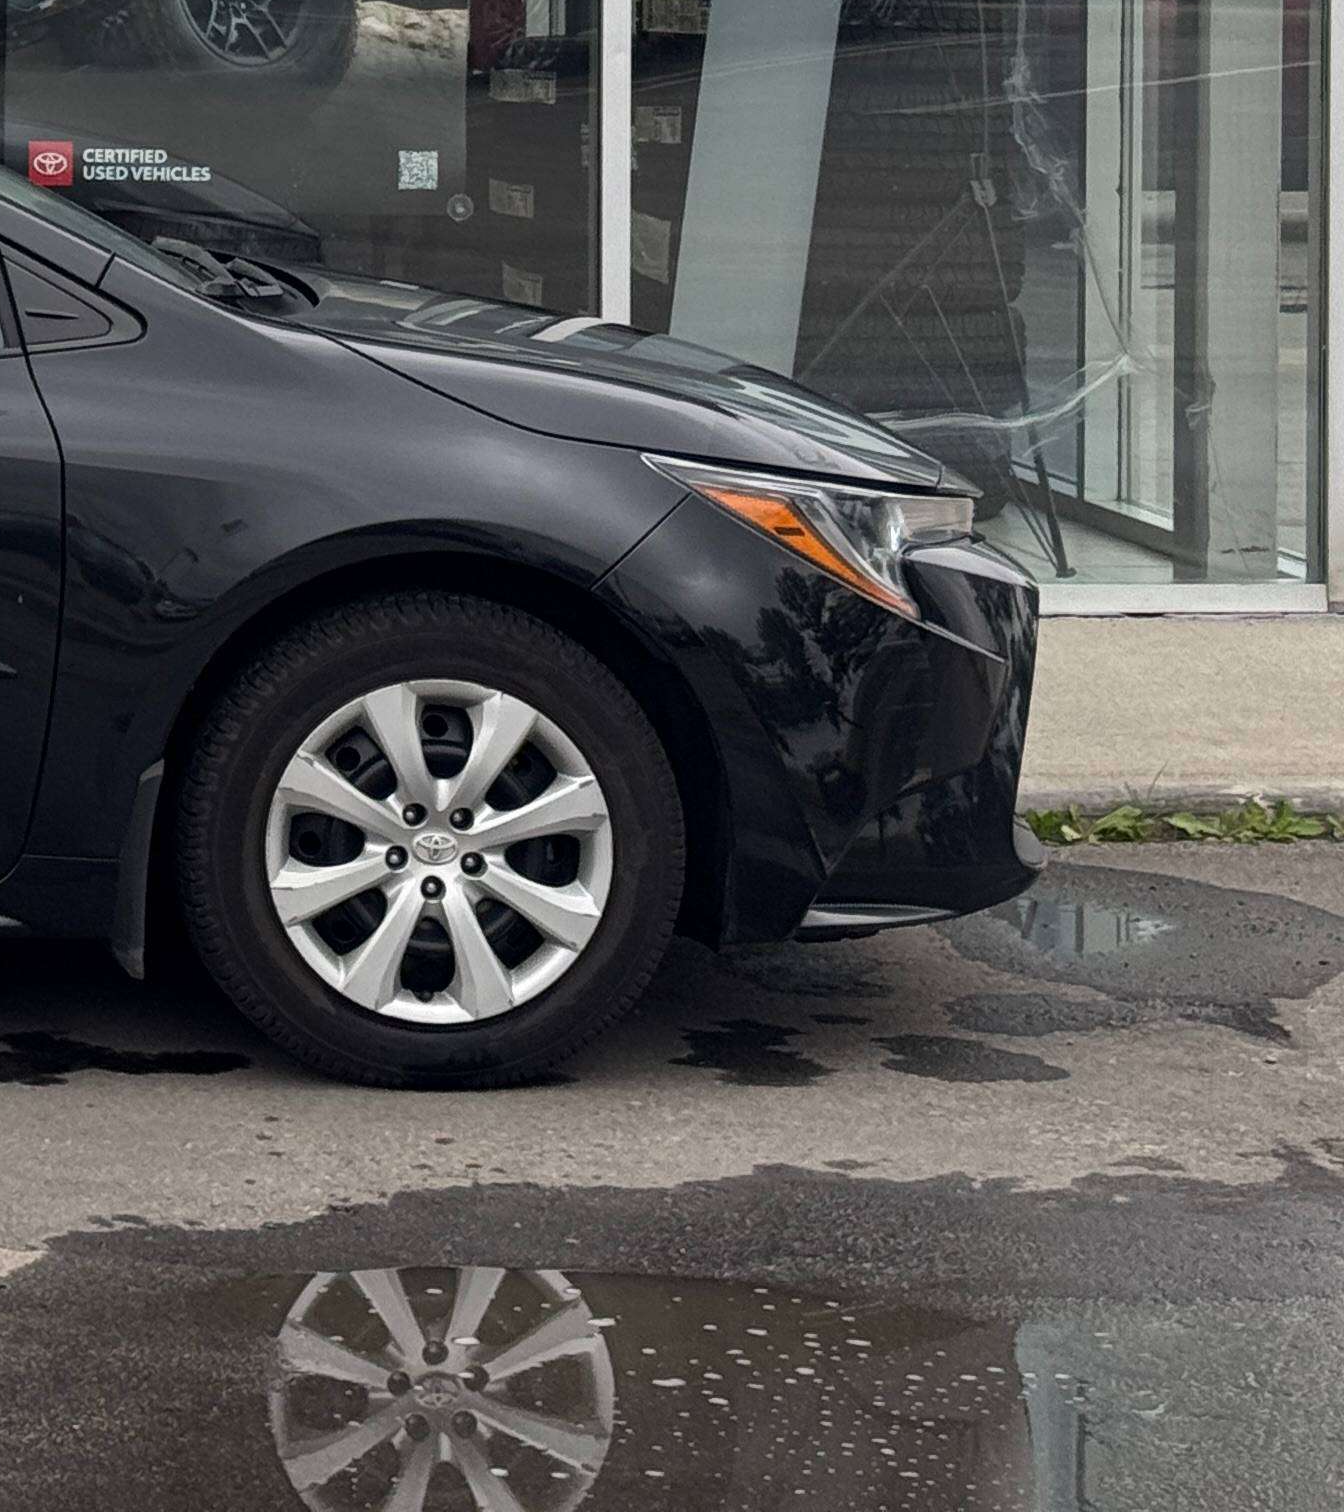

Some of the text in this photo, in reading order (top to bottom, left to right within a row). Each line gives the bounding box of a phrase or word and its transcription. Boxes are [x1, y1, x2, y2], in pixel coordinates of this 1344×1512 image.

[82, 148, 168, 164] CERTIFIED
[82, 165, 212, 182] USED VEHICLES
